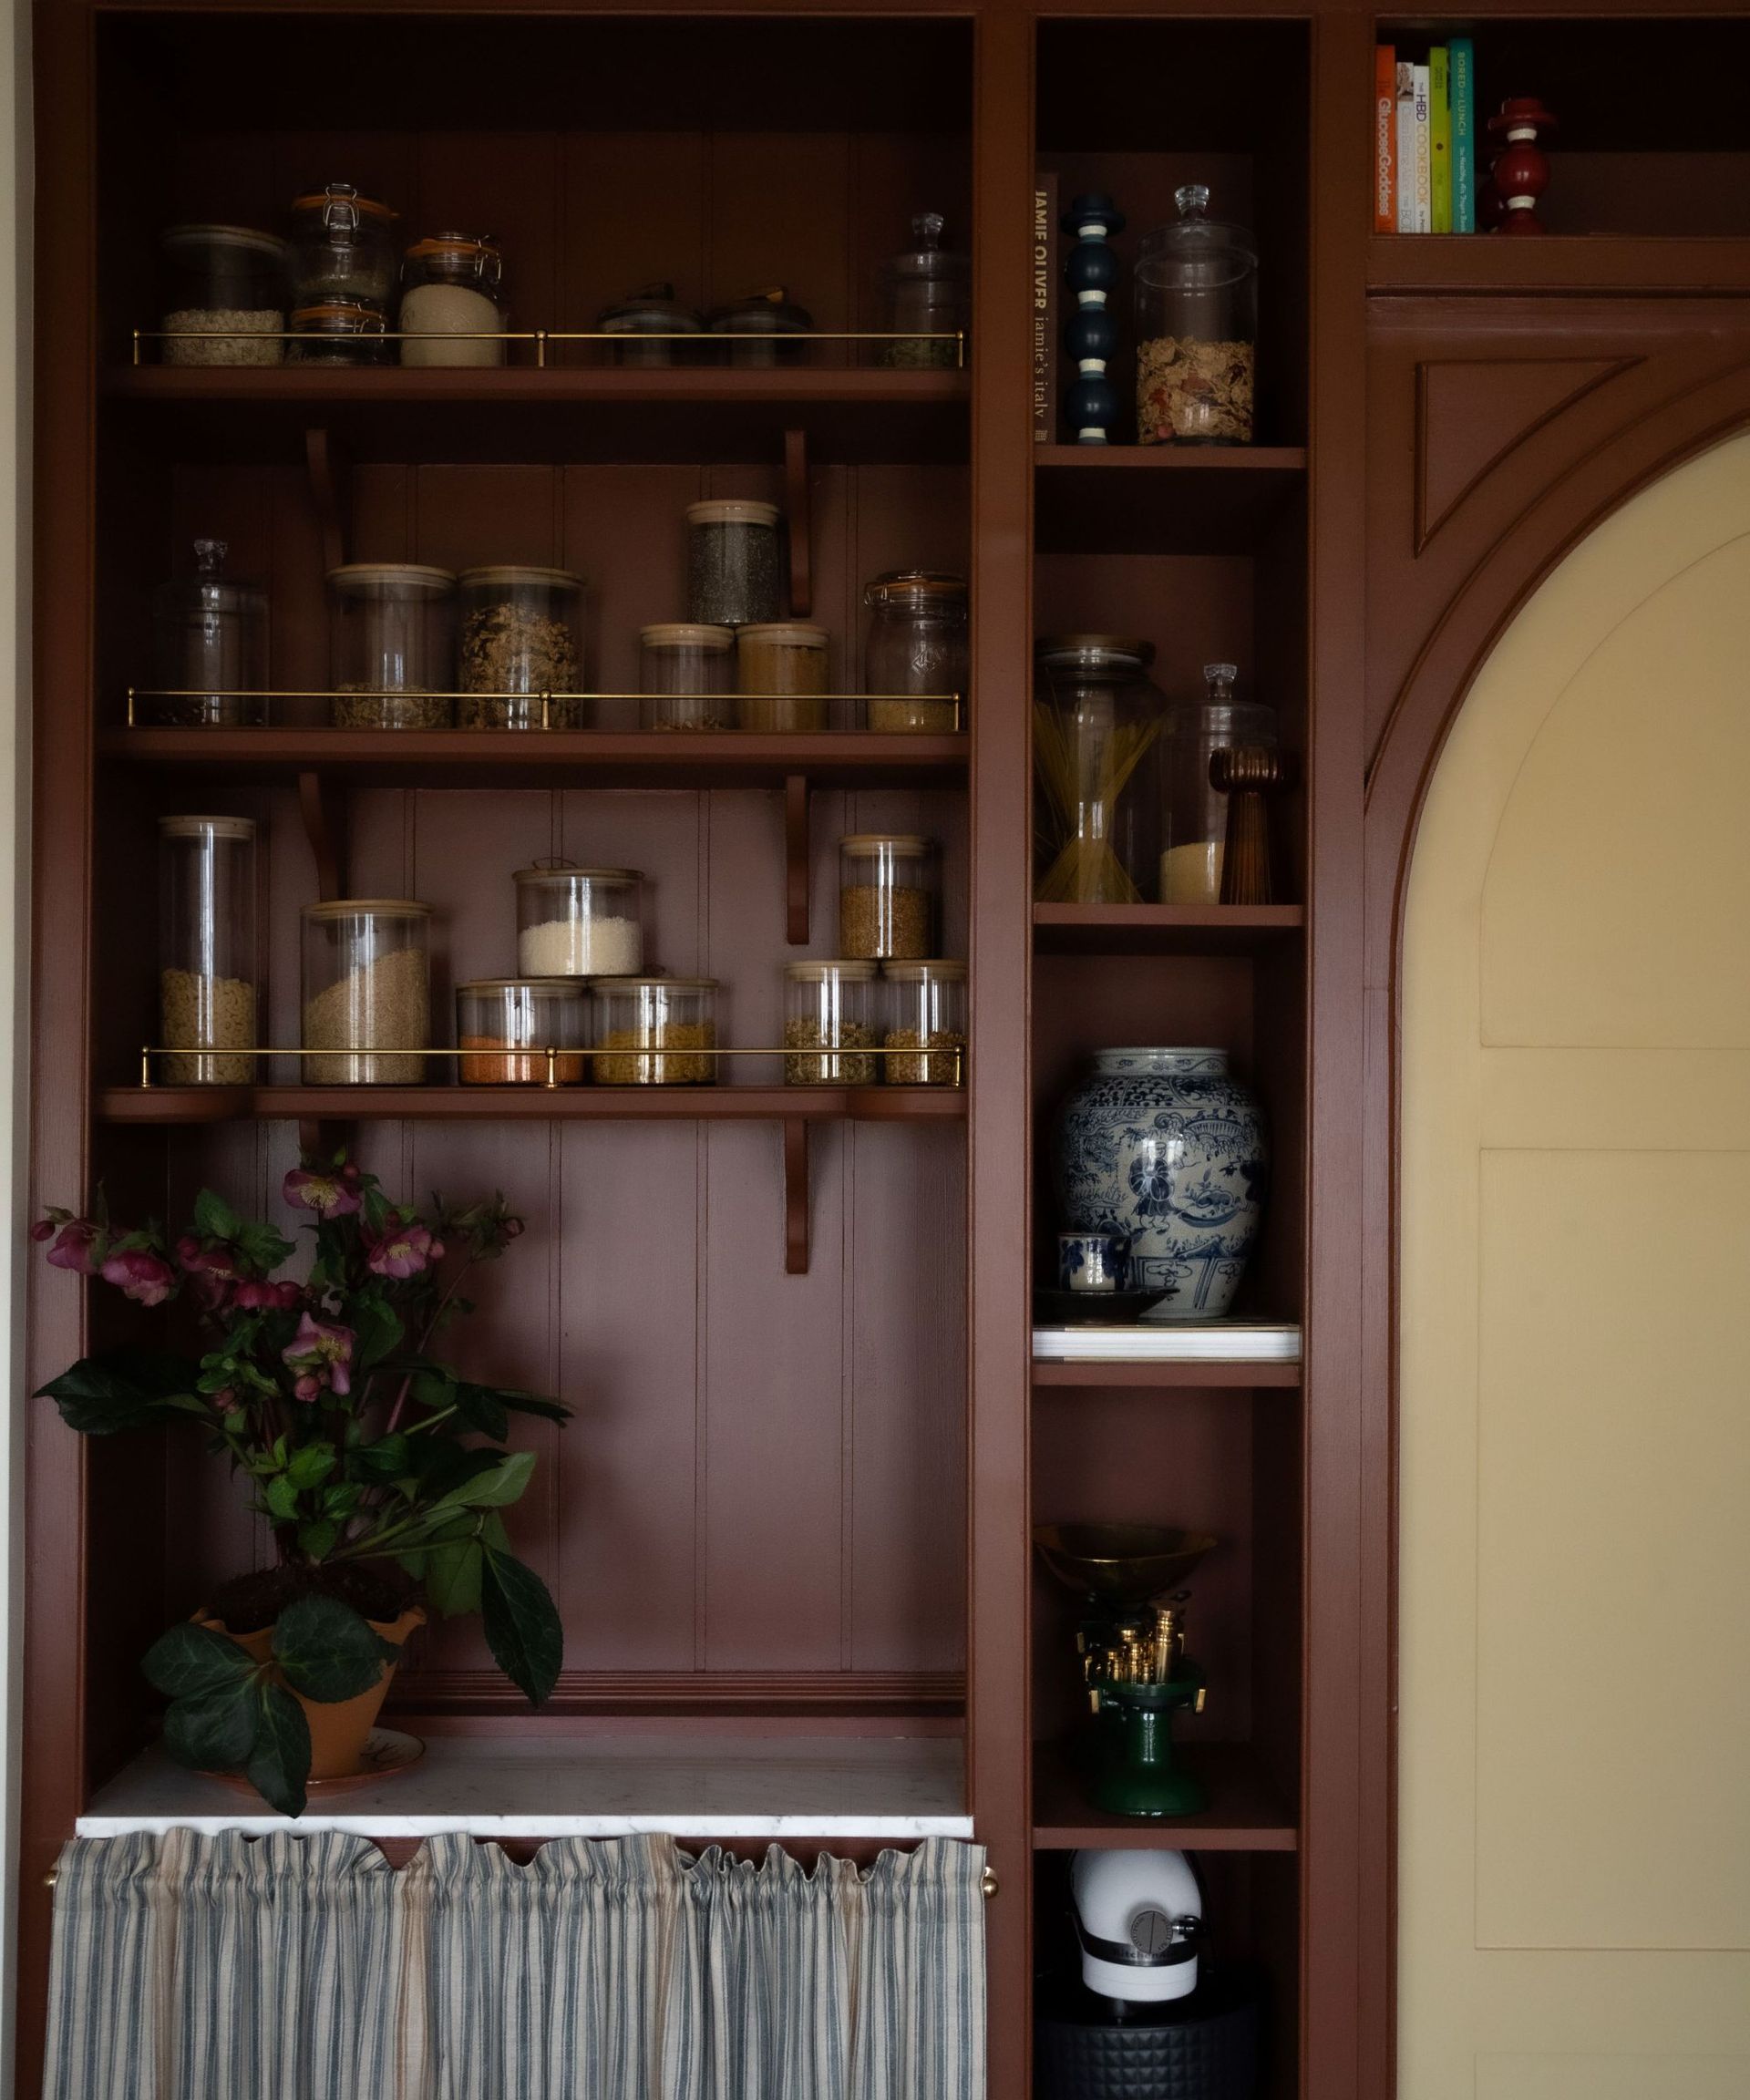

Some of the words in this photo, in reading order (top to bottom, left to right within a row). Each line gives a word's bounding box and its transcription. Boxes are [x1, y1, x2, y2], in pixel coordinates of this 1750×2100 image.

[1457, 51, 1466, 88] BORED
[1415, 94, 1426, 121] HBD
[1378, 98, 1392, 216] GlucoseGoddess
[1416, 124, 1428, 204] COOKBOOK
[1035, 191, 1047, 240] JAMIE
[1035, 245, 1047, 309] OLIVER
